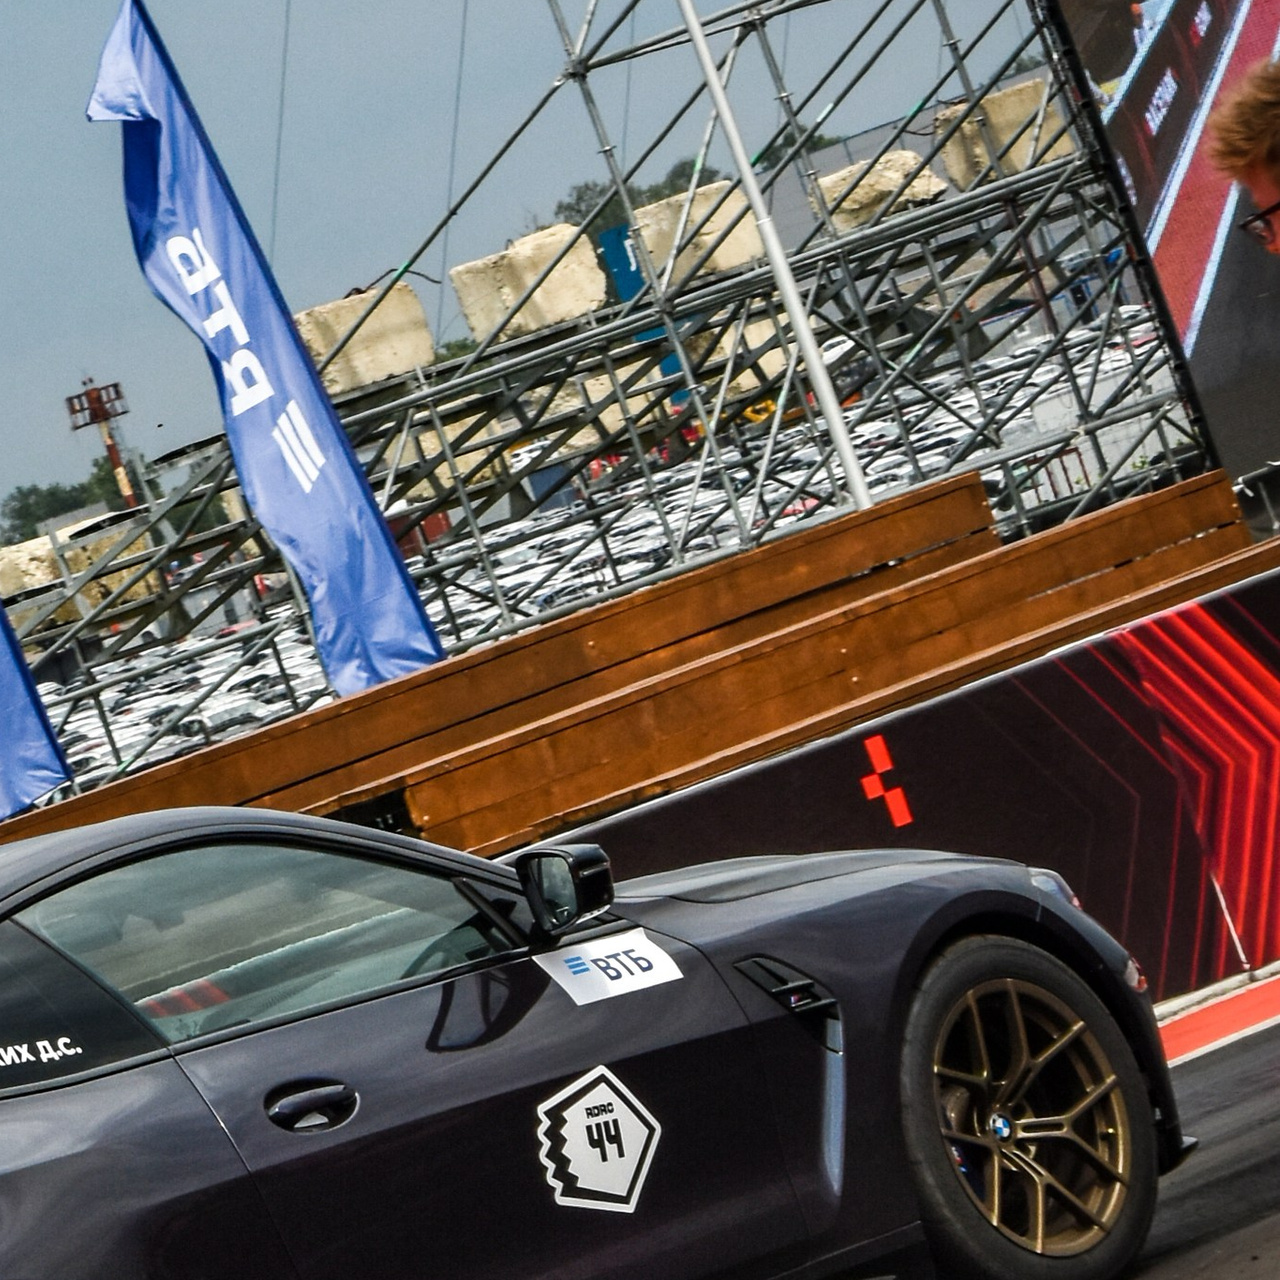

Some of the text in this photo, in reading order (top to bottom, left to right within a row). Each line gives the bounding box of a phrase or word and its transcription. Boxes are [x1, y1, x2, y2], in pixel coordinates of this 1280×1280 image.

[590, 949, 653, 981] ВТБ
[36, 1037, 83, 1063] Д.С.
[585, 1102, 614, 1119] RDRC
[585, 1118, 625, 1162] 44
